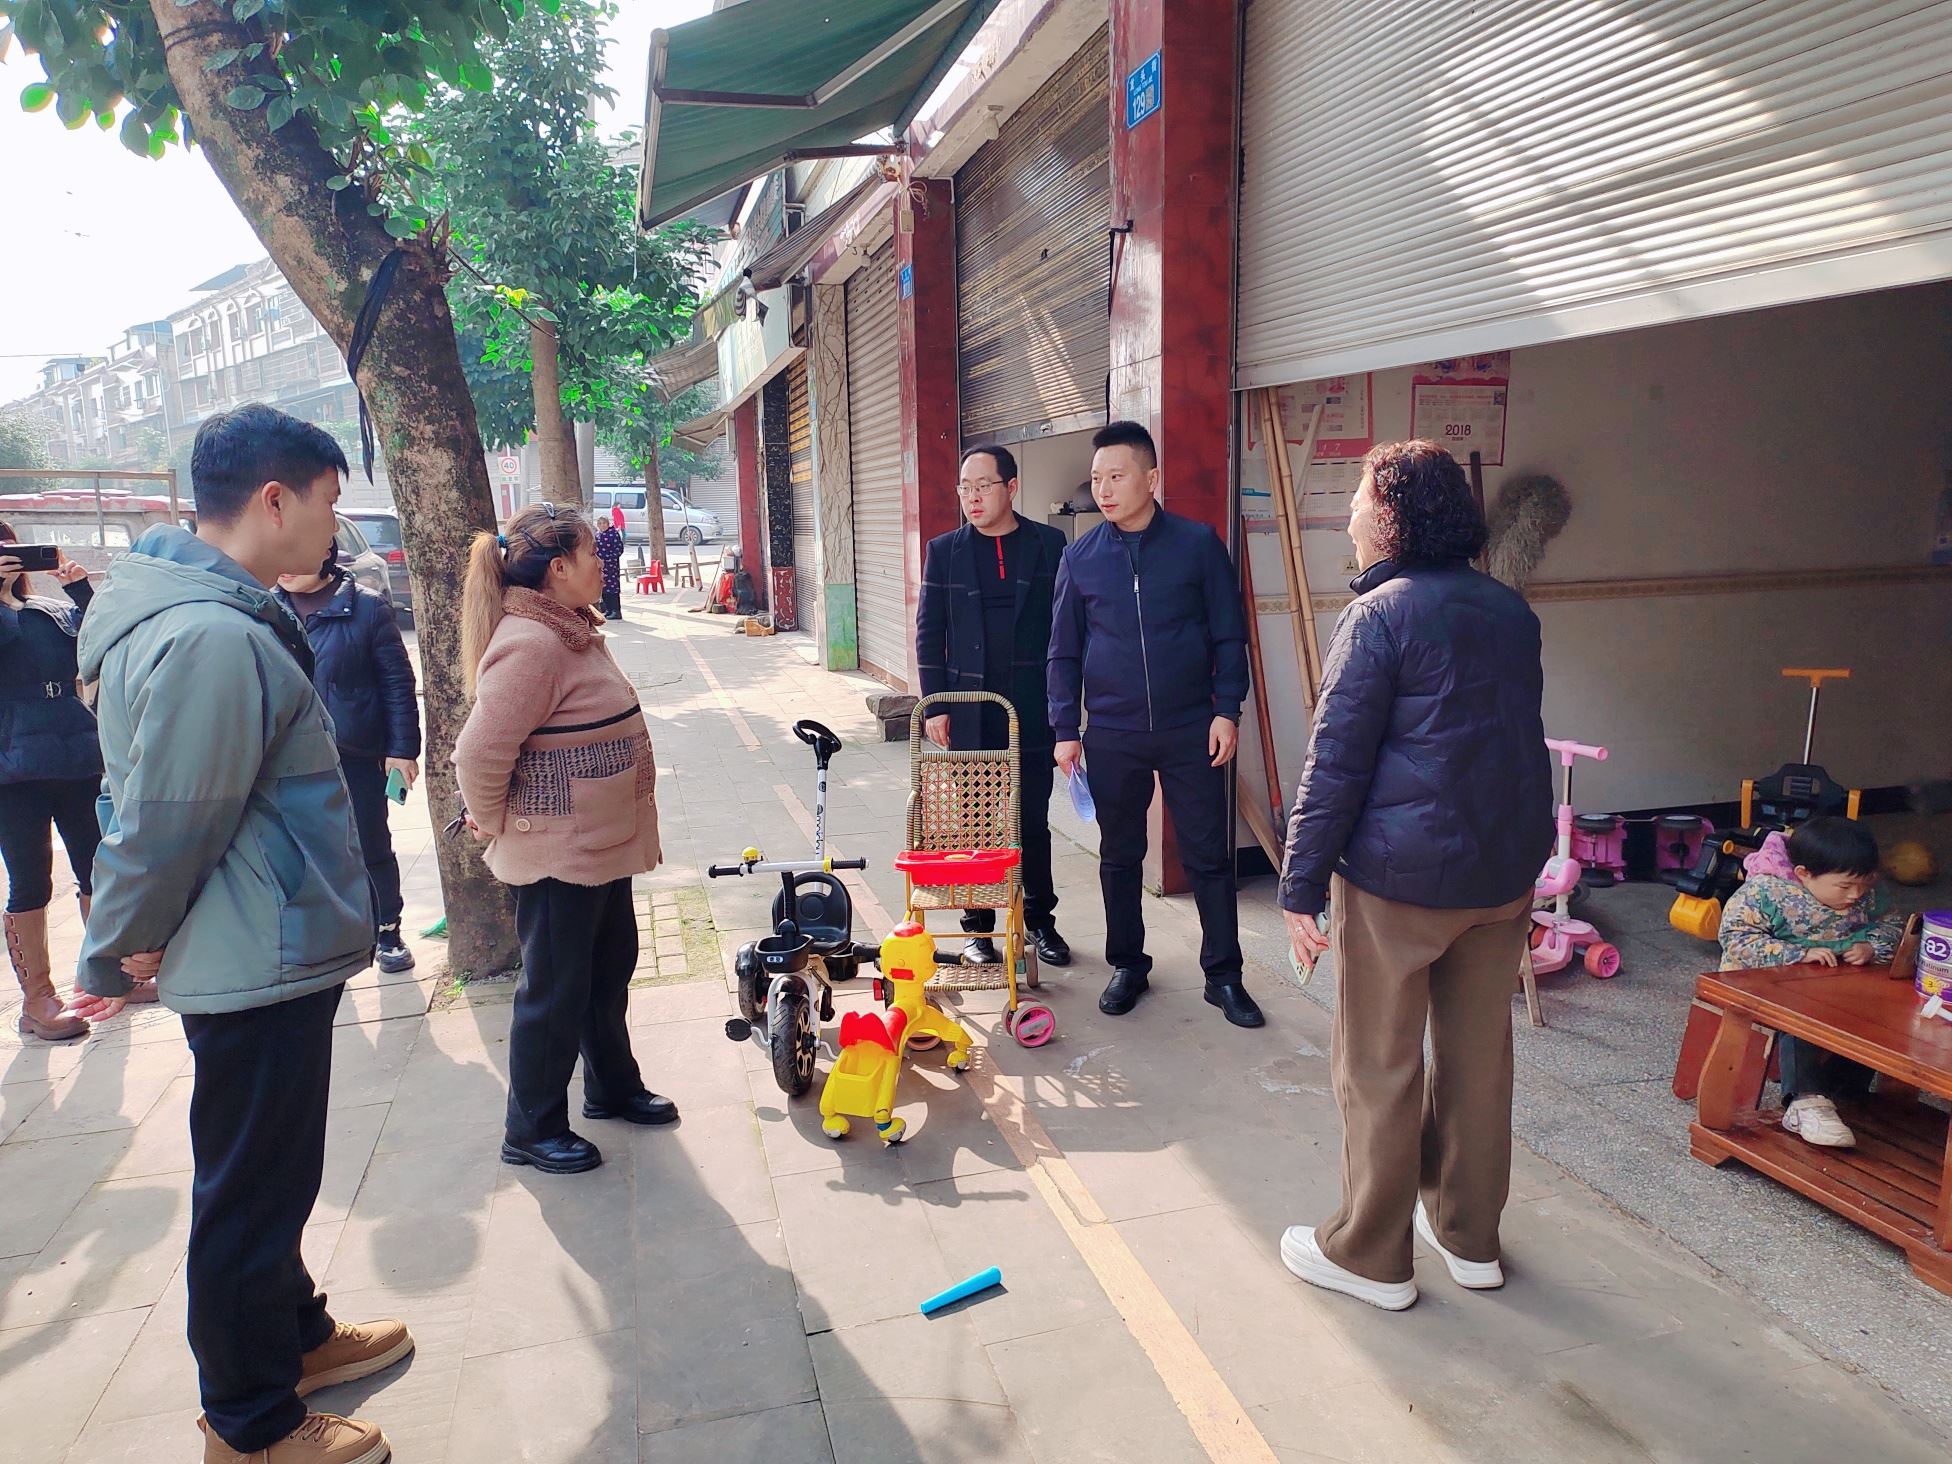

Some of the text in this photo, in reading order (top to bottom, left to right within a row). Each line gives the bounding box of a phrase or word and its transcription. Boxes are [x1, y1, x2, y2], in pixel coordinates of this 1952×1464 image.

[1133, 91, 1146, 120] 129
[1445, 424, 1472, 436] 2018
[503, 461, 515, 470] 40
[1926, 939, 1947, 958] a2
